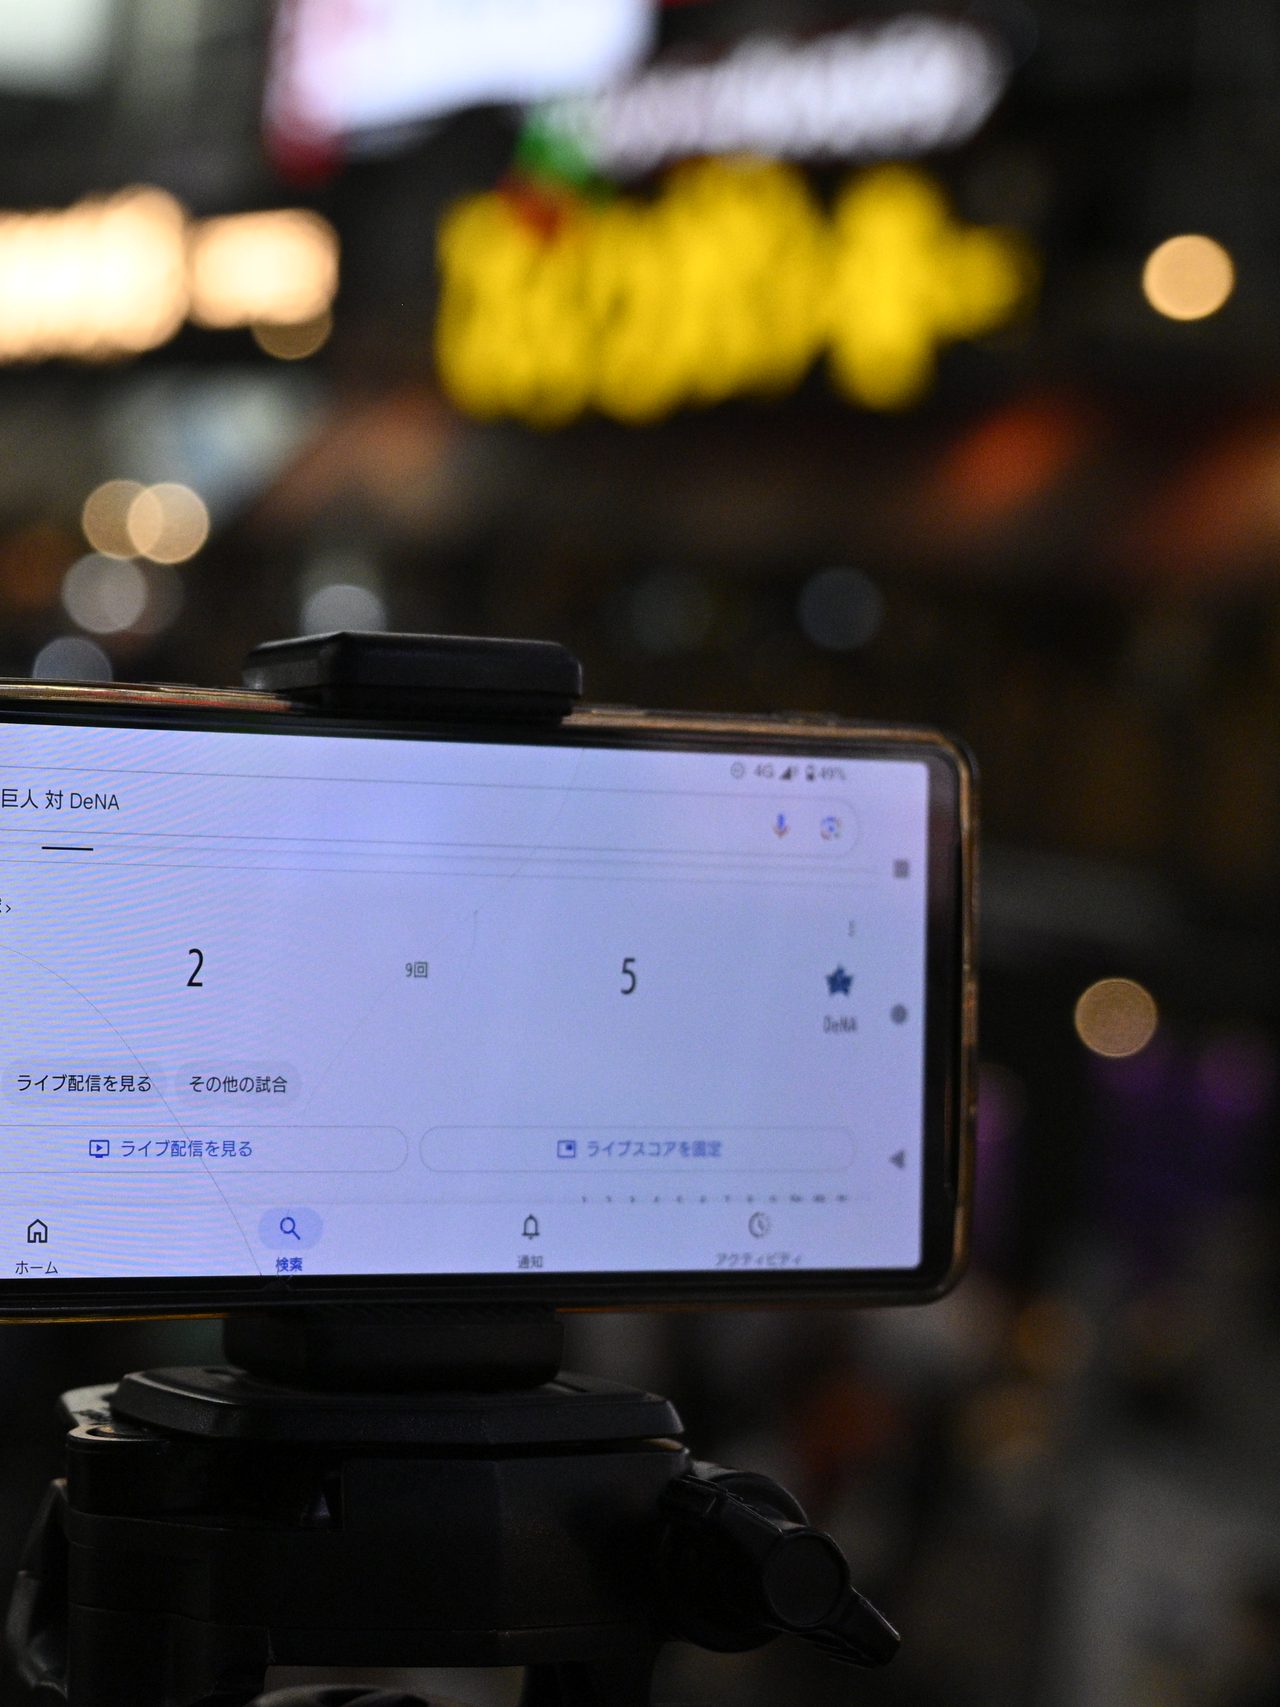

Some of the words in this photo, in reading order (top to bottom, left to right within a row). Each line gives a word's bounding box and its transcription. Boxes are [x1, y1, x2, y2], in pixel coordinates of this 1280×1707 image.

[1, 788, 39, 809] 巨人
[45, 789, 64, 810] 対
[70, 792, 120, 811] DeNA
[186, 948, 204, 988] 2
[405, 961, 428, 978] 9回
[620, 957, 637, 995] 5
[16, 1074, 152, 1093] ライブ配信を見る
[188, 1075, 288, 1094] その他の試合
[120, 1139, 253, 1158] ライブ配信を見る
[15, 1260, 59, 1275] ホーム
[275, 1256, 304, 1273] 検索
